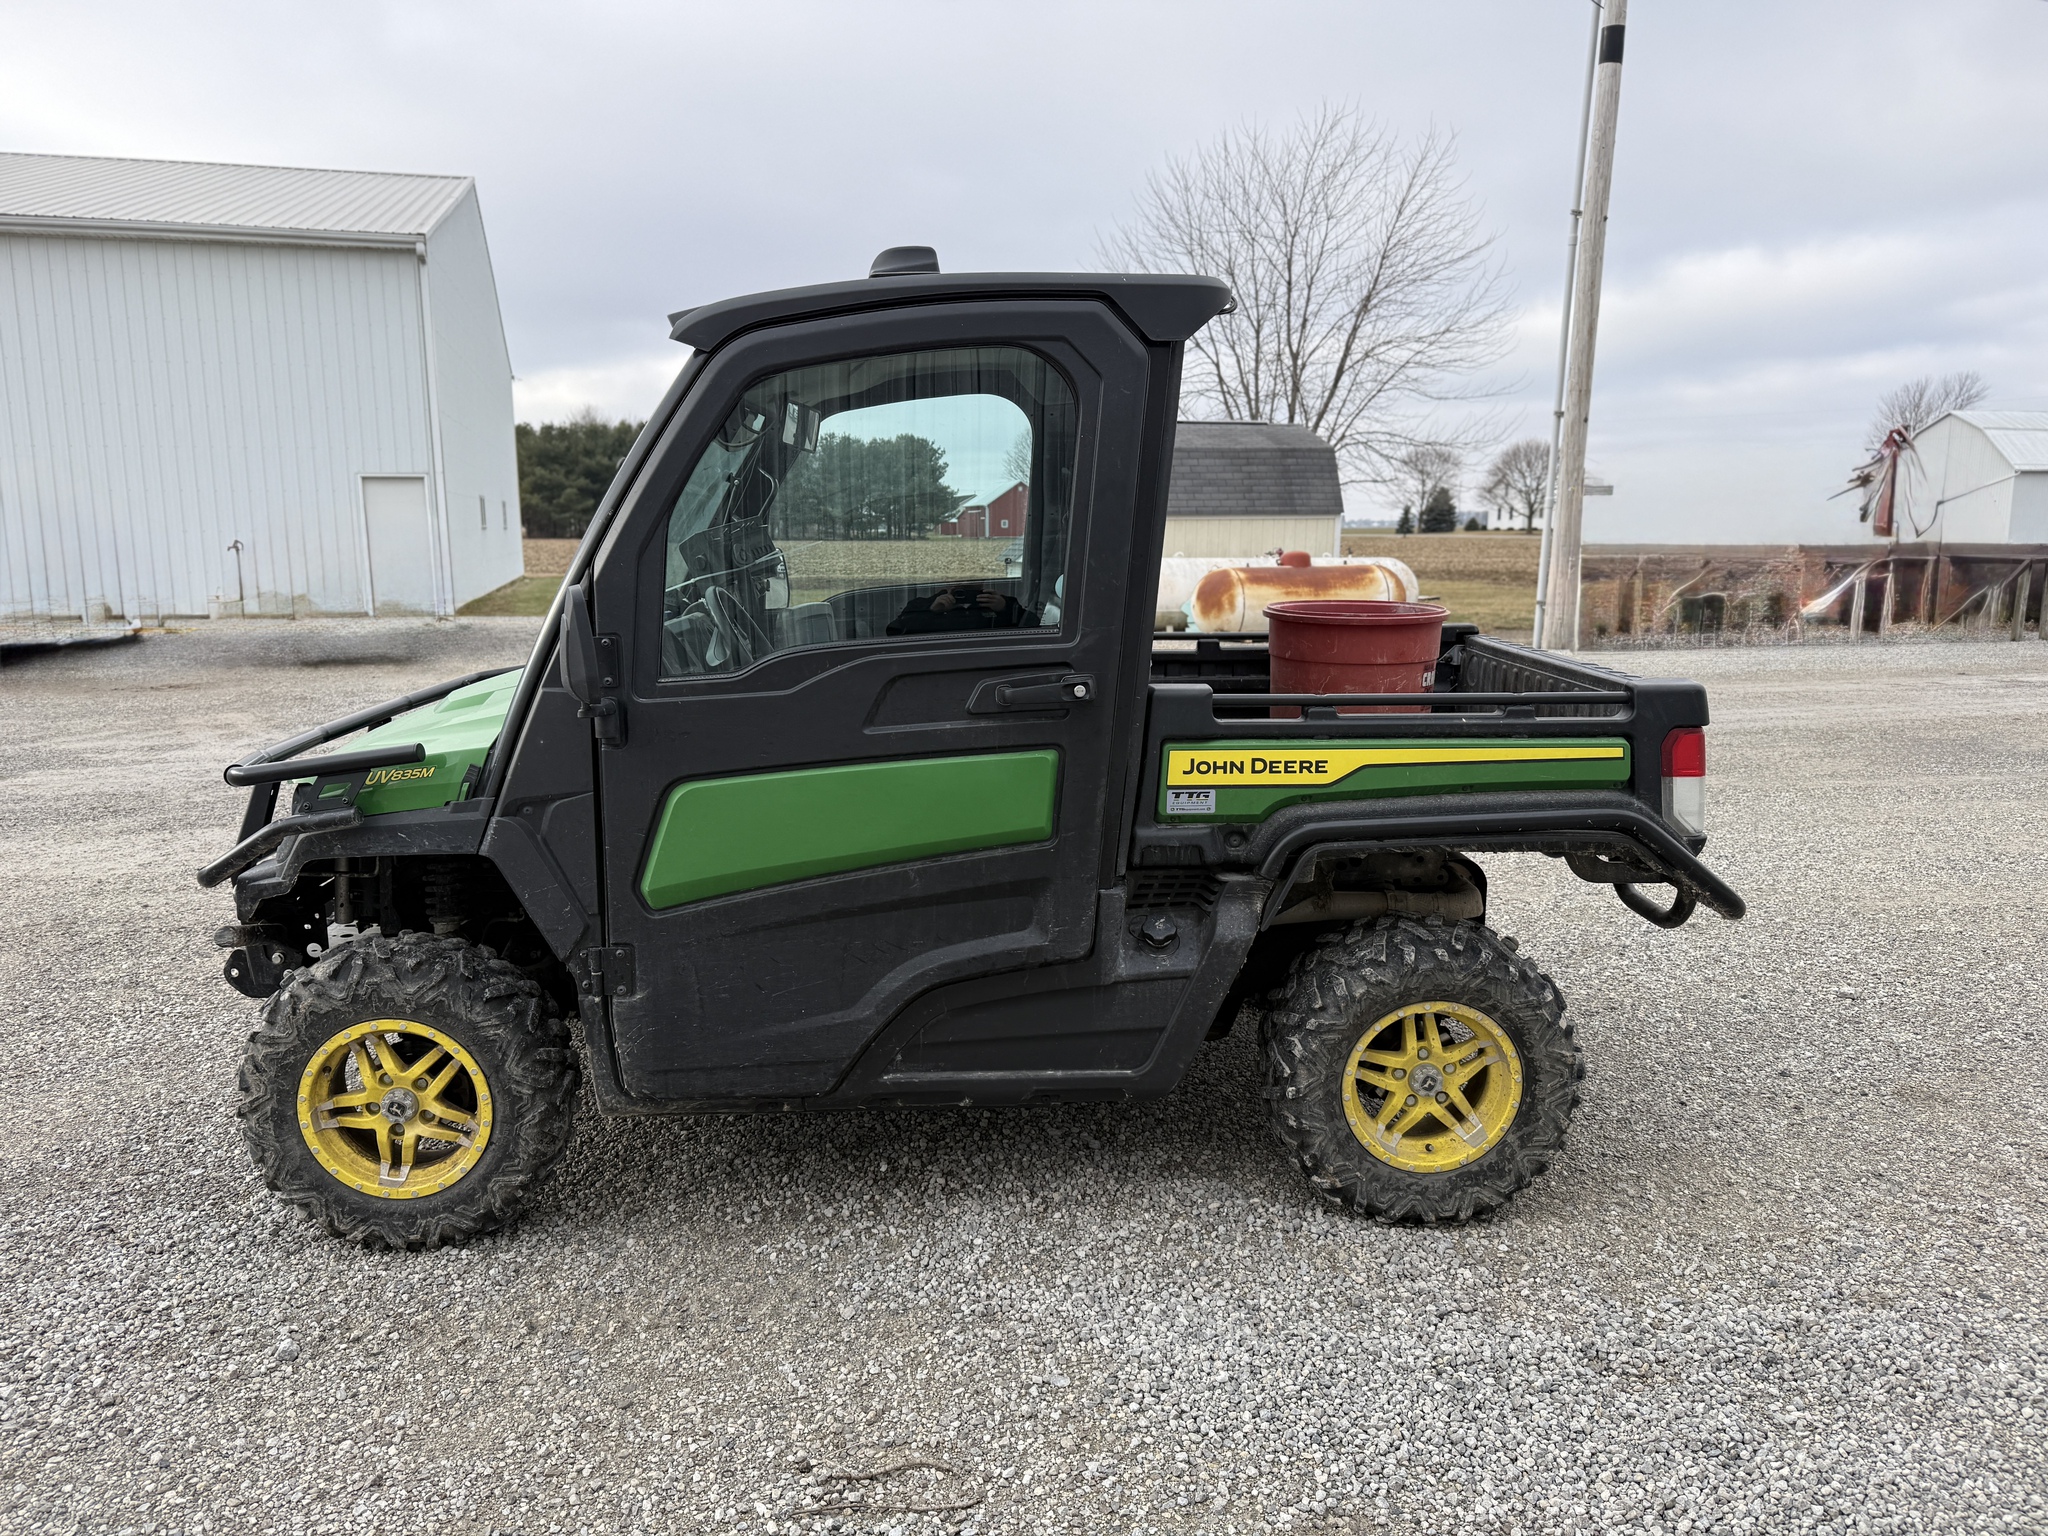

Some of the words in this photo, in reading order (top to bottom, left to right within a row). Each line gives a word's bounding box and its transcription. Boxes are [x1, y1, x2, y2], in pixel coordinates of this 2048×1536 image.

[1182, 758, 1244, 775] JOHN
[1251, 757, 1328, 774] DEERE
[365, 766, 435, 785] UV835M
[1171, 791, 1211, 800] TTG
